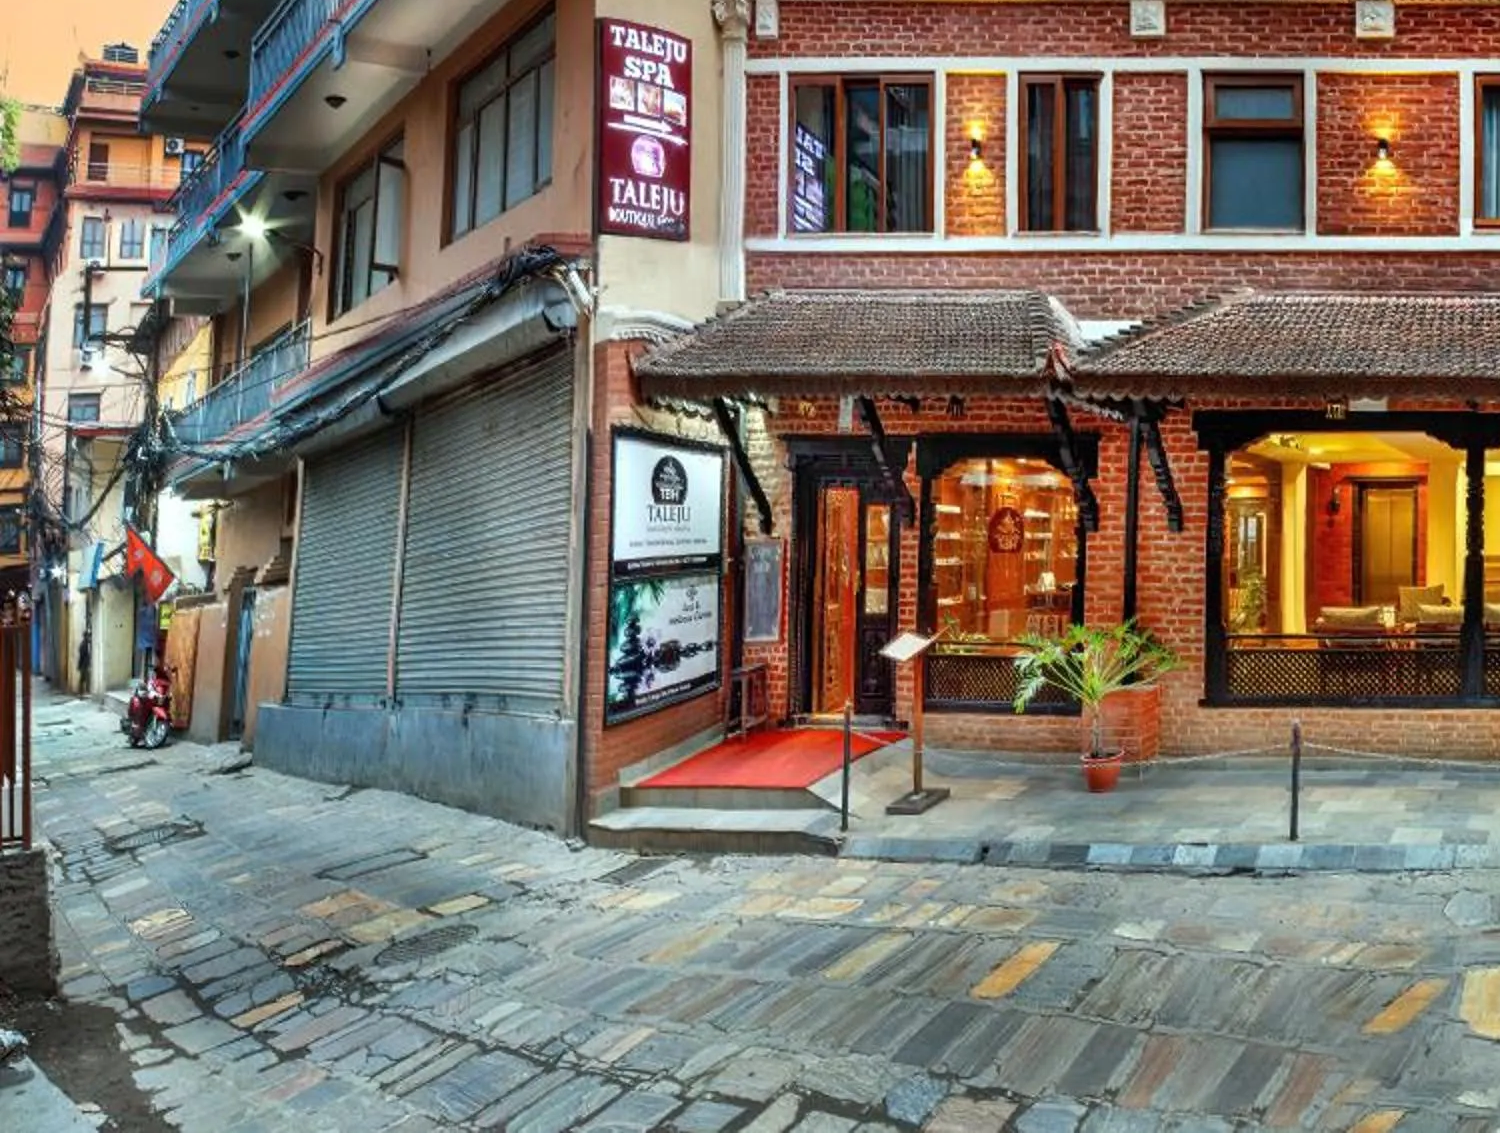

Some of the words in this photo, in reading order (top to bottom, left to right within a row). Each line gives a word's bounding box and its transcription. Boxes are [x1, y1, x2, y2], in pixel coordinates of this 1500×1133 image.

[610, 26, 686, 63] TALEJU
[623, 56, 675, 89] SPA
[609, 178, 685, 216] TALEJU
[646, 504, 691, 523] TALEJU
